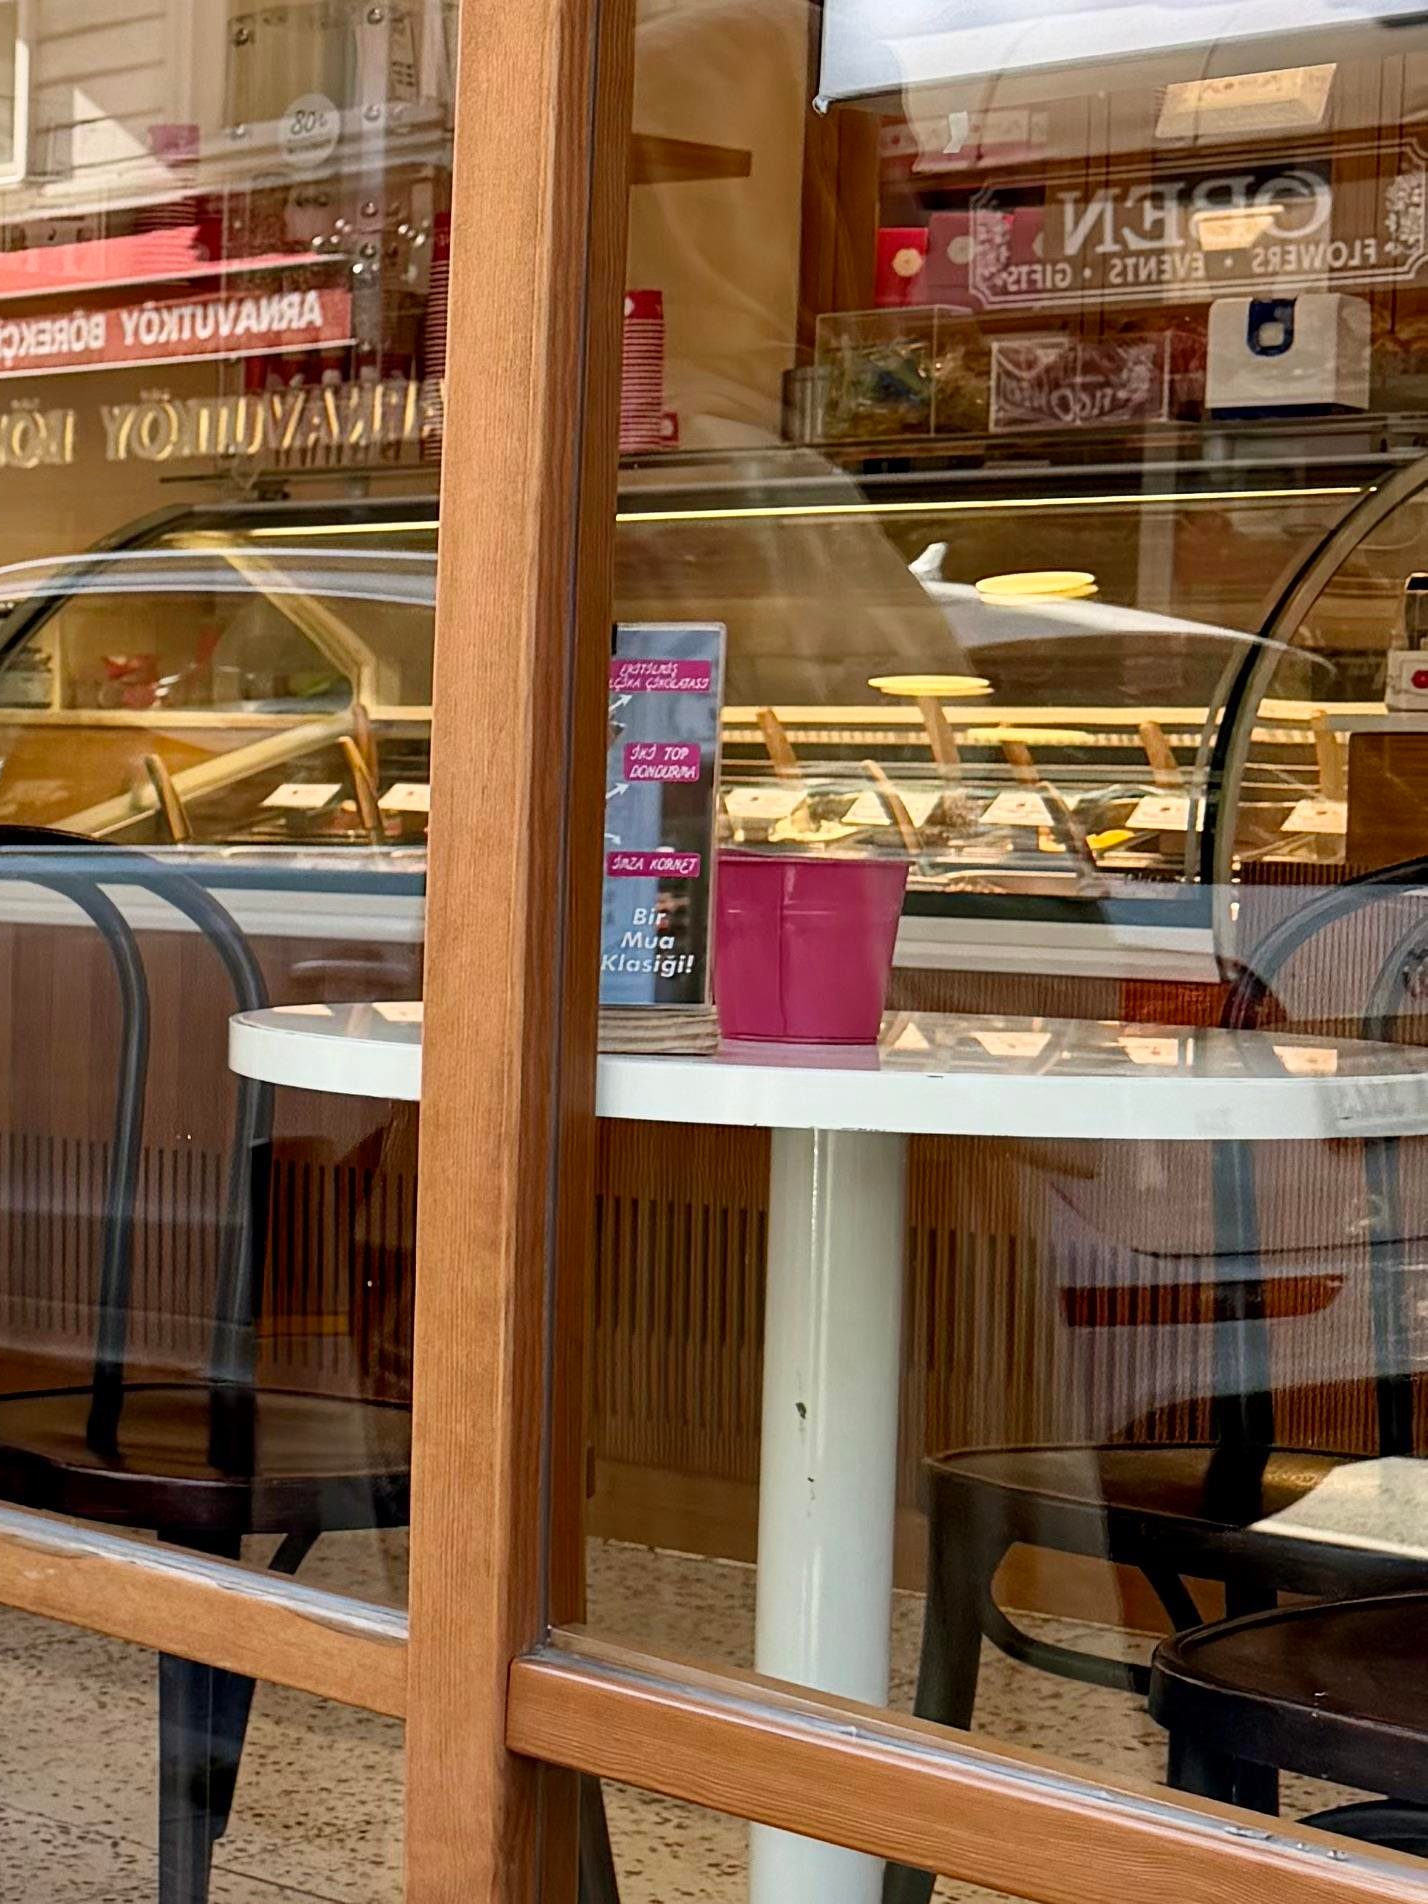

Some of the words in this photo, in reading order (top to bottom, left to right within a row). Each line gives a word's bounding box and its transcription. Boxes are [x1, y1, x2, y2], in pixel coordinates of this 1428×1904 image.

[663, 746, 690, 761] TOP
[629, 764, 697, 779] DONDURMA
[649, 857, 698, 874] KORNET
[632, 907, 667, 926] Bir
[620, 931, 675, 950] Mua
[600, 954, 695, 978] Klasiği!
